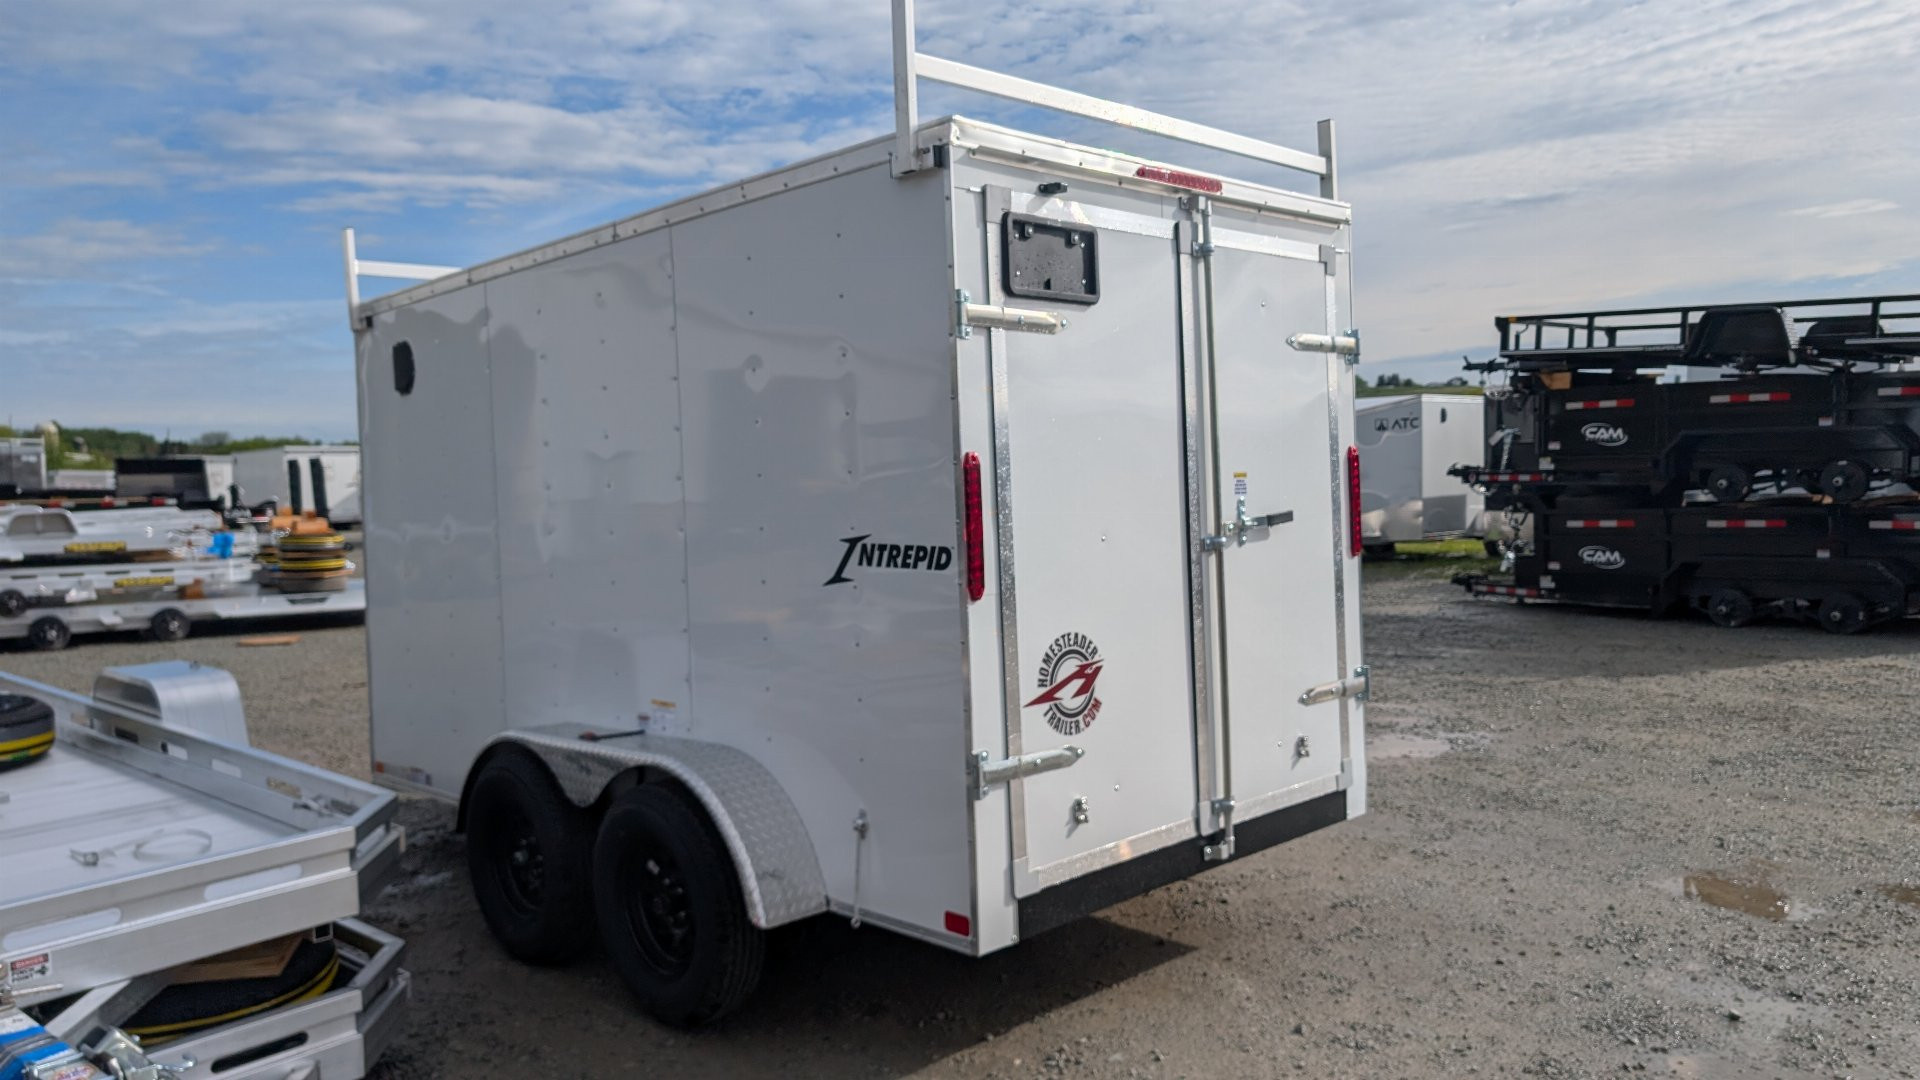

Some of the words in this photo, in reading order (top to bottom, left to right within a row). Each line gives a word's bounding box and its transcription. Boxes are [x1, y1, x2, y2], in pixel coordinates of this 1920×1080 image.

[1391, 417, 1419, 430] ATC
[822, 533, 953, 587] INTREPID
[1037, 632, 1099, 688] HOMESTEADER
